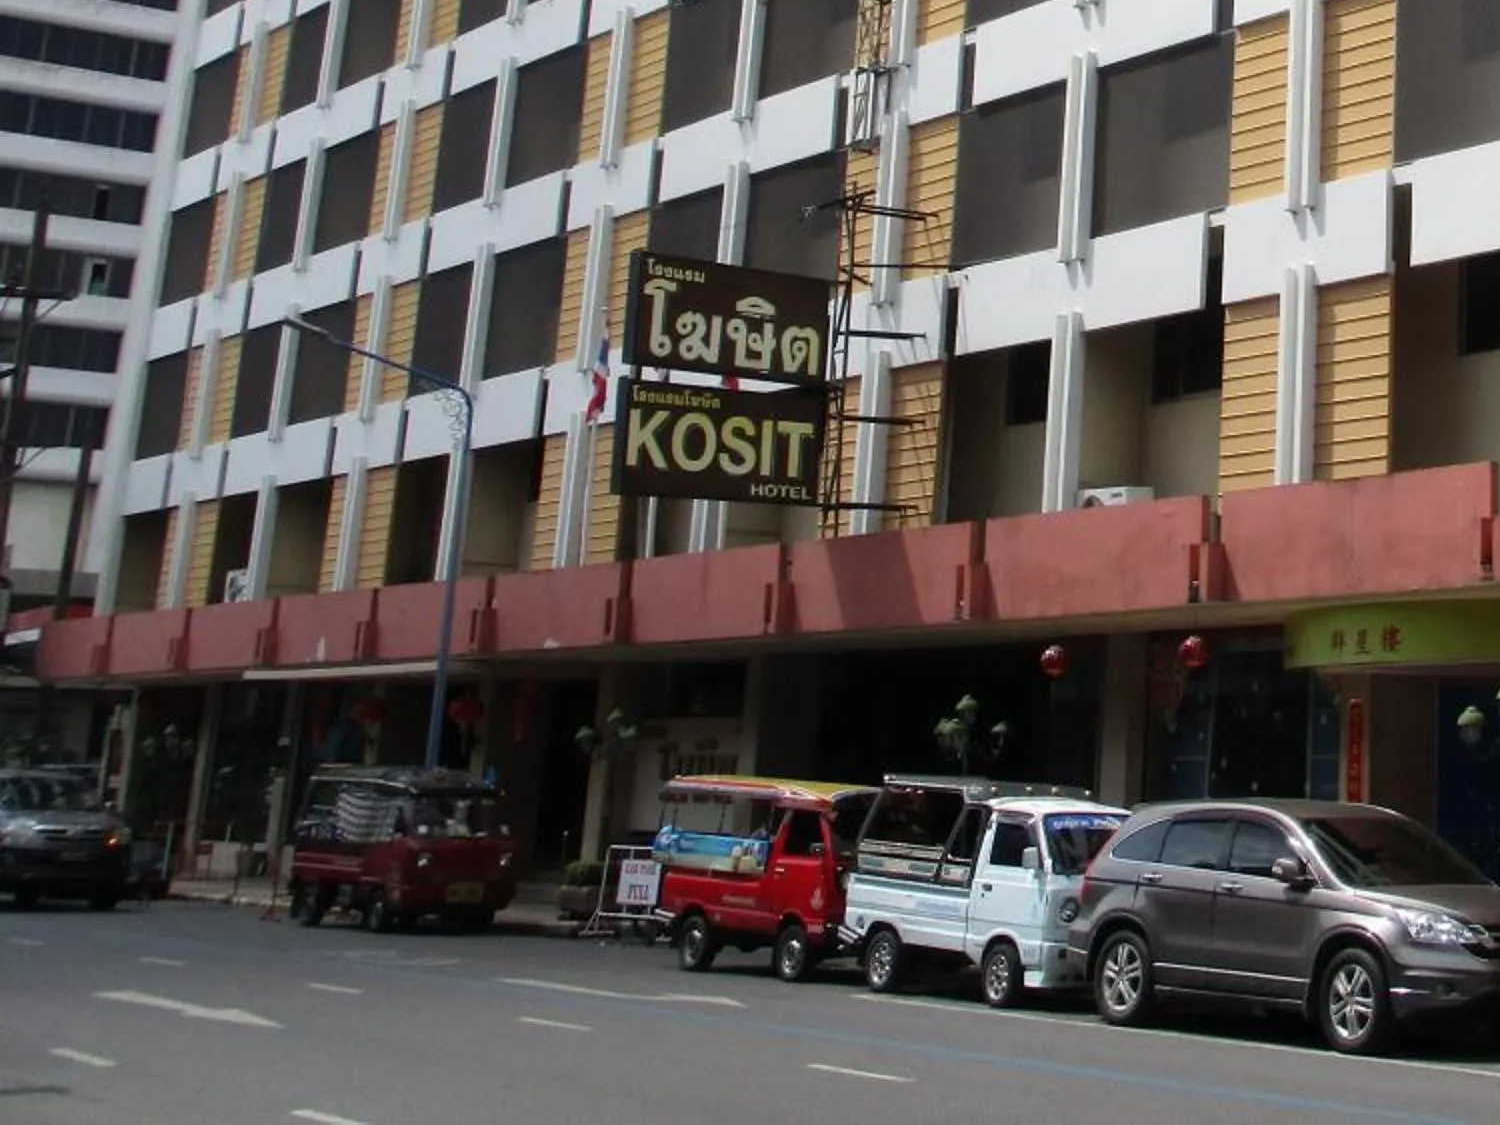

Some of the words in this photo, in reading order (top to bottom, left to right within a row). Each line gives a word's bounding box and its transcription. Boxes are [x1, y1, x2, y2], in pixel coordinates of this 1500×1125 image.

[647, 258, 705, 284] โรงแรม
[643, 278, 821, 376] โฆษิต
[625, 408, 815, 478] KOSIT
[751, 483, 811, 500] HOTEL
